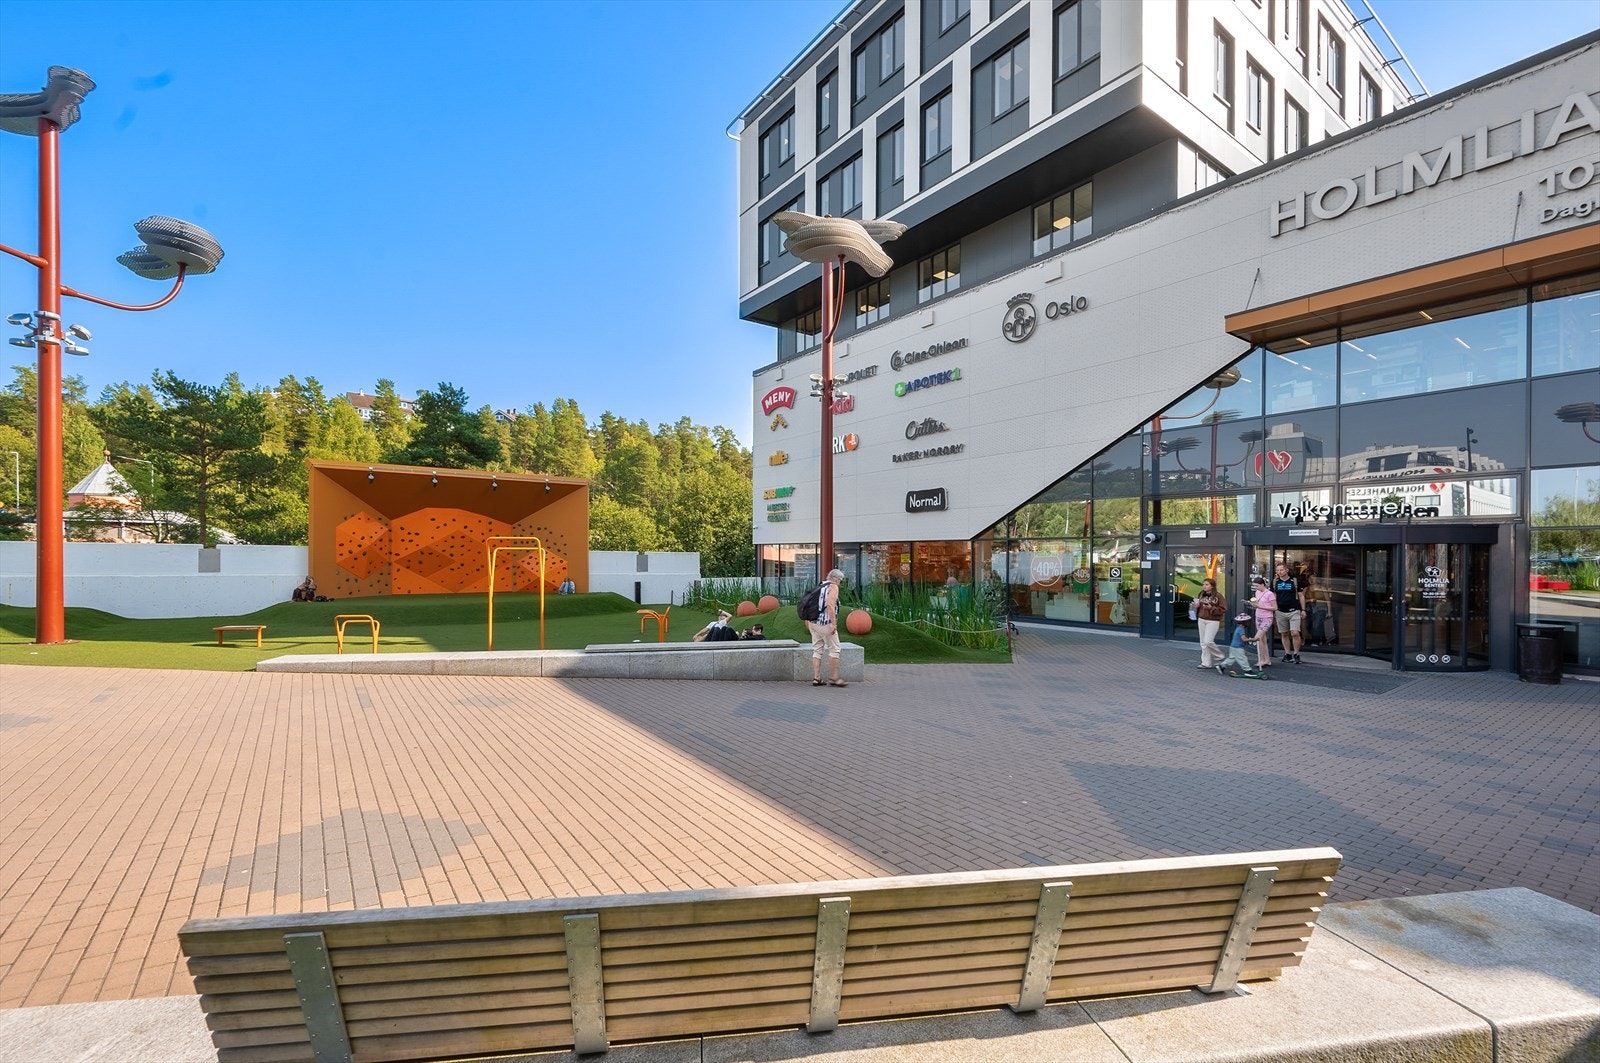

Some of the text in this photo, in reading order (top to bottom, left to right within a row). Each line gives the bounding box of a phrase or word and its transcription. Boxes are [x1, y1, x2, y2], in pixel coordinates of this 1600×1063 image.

[1270, 91, 1600, 237] HOLMLIA
[1541, 199, 1600, 224] Dag
[1045, 295, 1087, 320] Oslo
[764, 391, 791, 409] MENY
[909, 493, 942, 508] Normal
[1278, 500, 1414, 519] Velkommen
[1338, 530, 1352, 542] A
